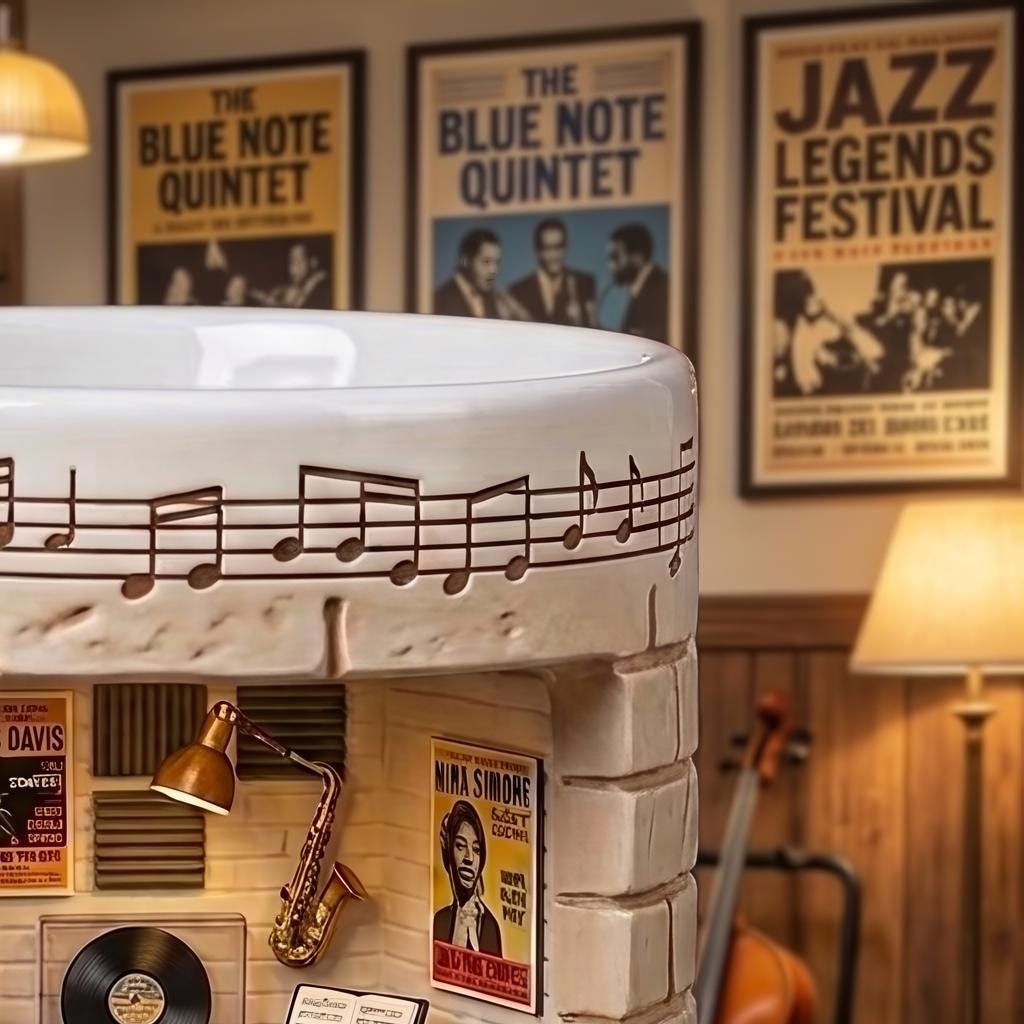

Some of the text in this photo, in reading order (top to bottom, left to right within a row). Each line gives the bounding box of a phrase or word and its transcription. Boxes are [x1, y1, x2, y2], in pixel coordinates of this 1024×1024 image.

[210, 86, 256, 114] THE
[521, 64, 579, 97] THE
[775, 46, 996, 135] JAZZ
[139, 111, 331, 166] BLUE NOTE
[438, 94, 666, 156] BLUE NOTE
[460, 149, 640, 209] QUINTET
[775, 125, 994, 188] LEGENDS
[158, 161, 309, 215] QUINTET
[775, 183, 994, 242] FESTIVAL
[8, 725, 63, 751] DAVIS
